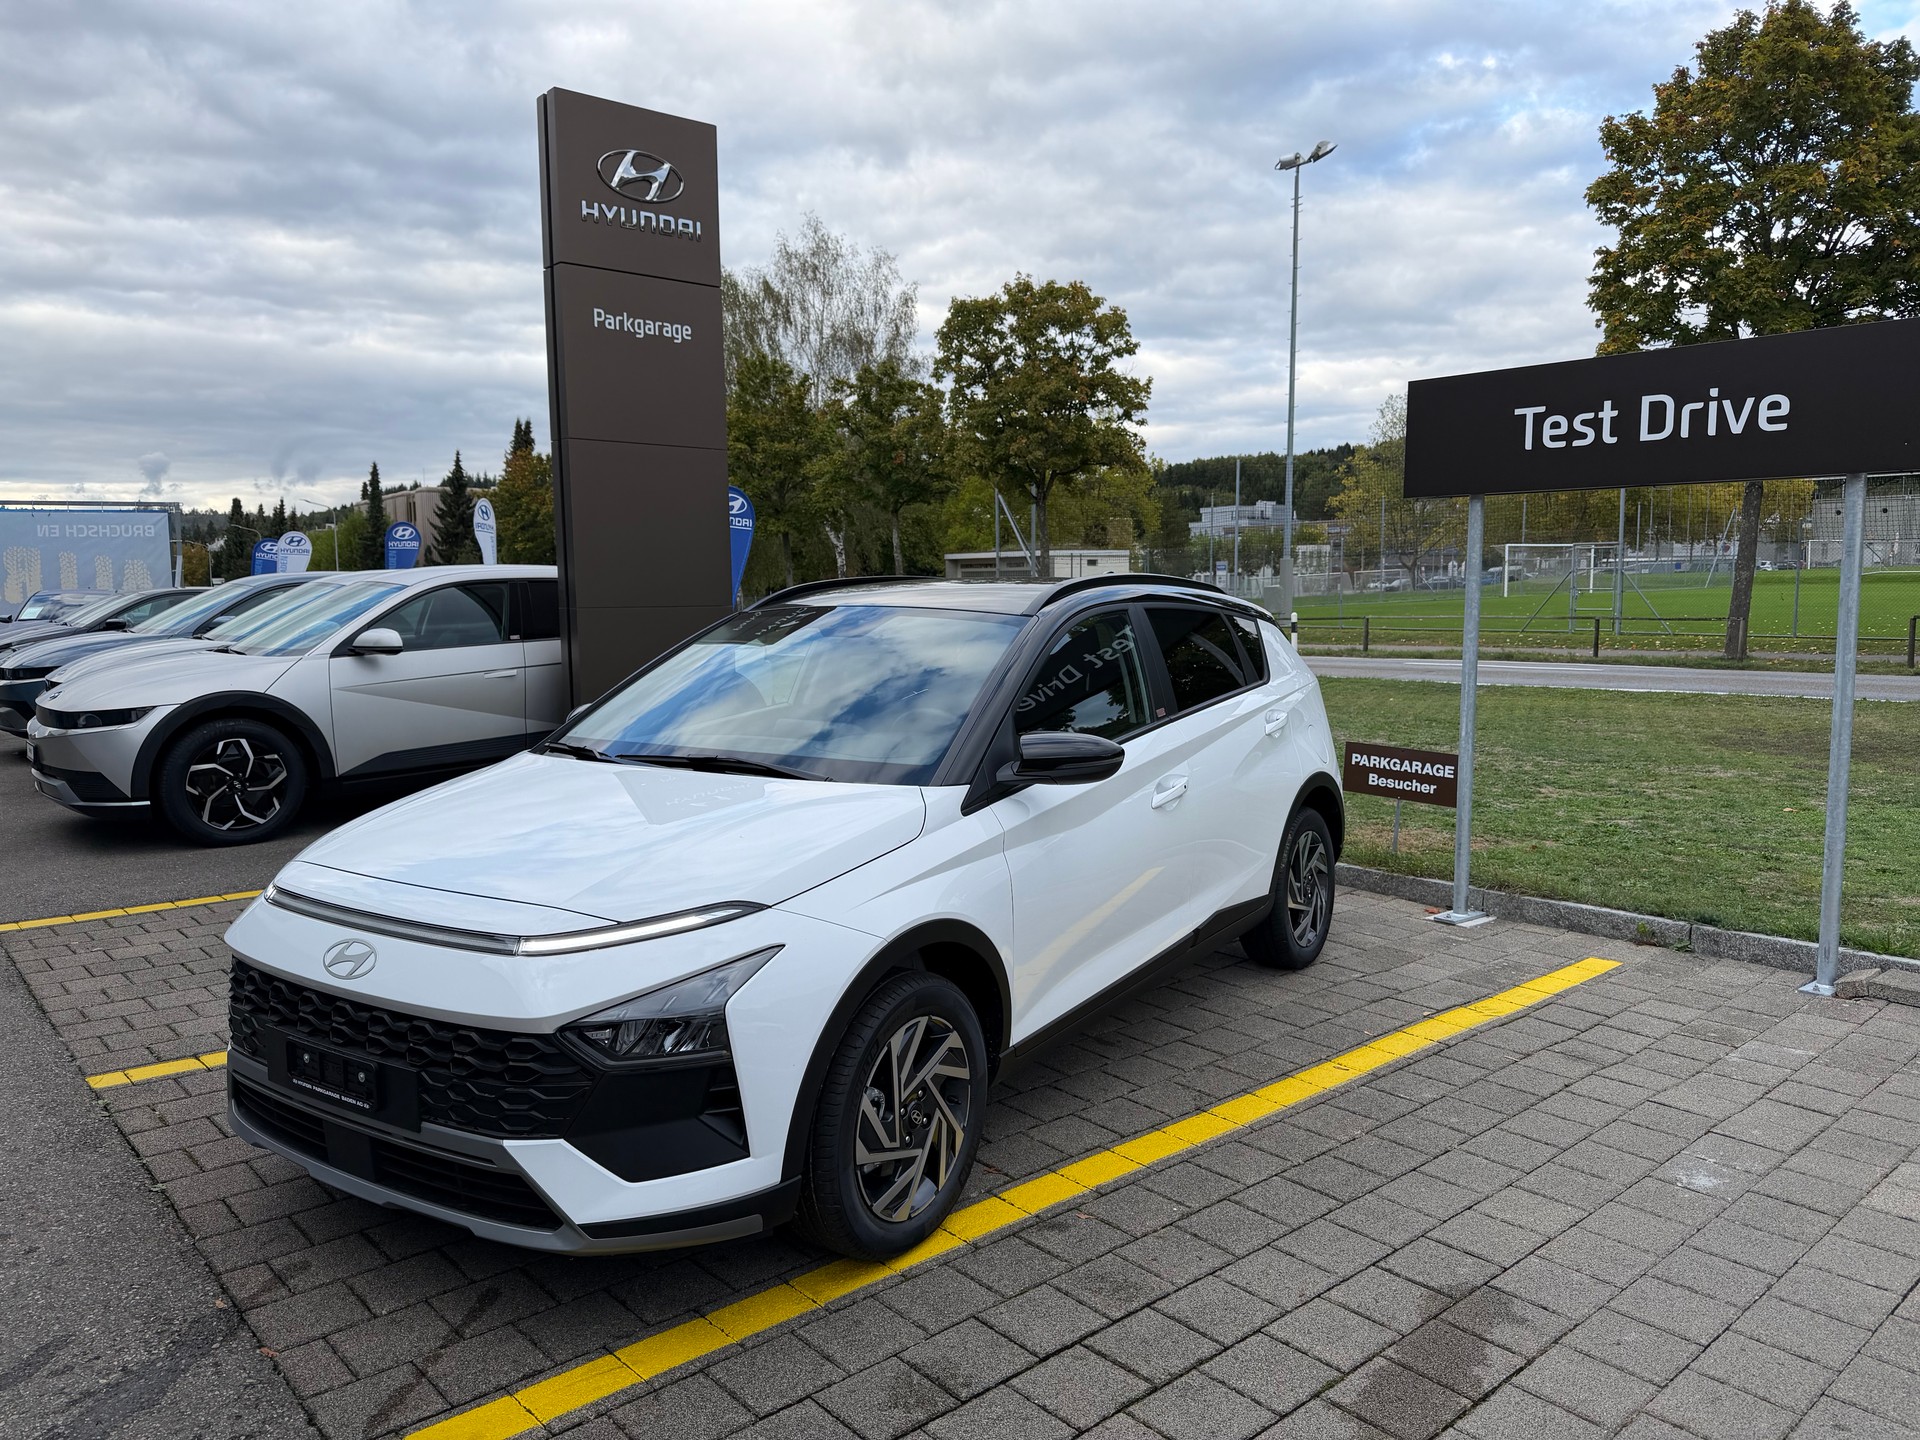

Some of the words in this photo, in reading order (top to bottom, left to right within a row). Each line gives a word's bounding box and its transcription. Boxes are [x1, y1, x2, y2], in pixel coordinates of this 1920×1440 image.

[581, 200, 702, 242] HYUNDAI
[593, 307, 692, 343] Parkgarage
[1514, 400, 1619, 451] Test
[1639, 387, 1791, 442] Drive
[1351, 753, 1455, 779] PARKGARAGE
[1368, 773, 1437, 794] Besucher
